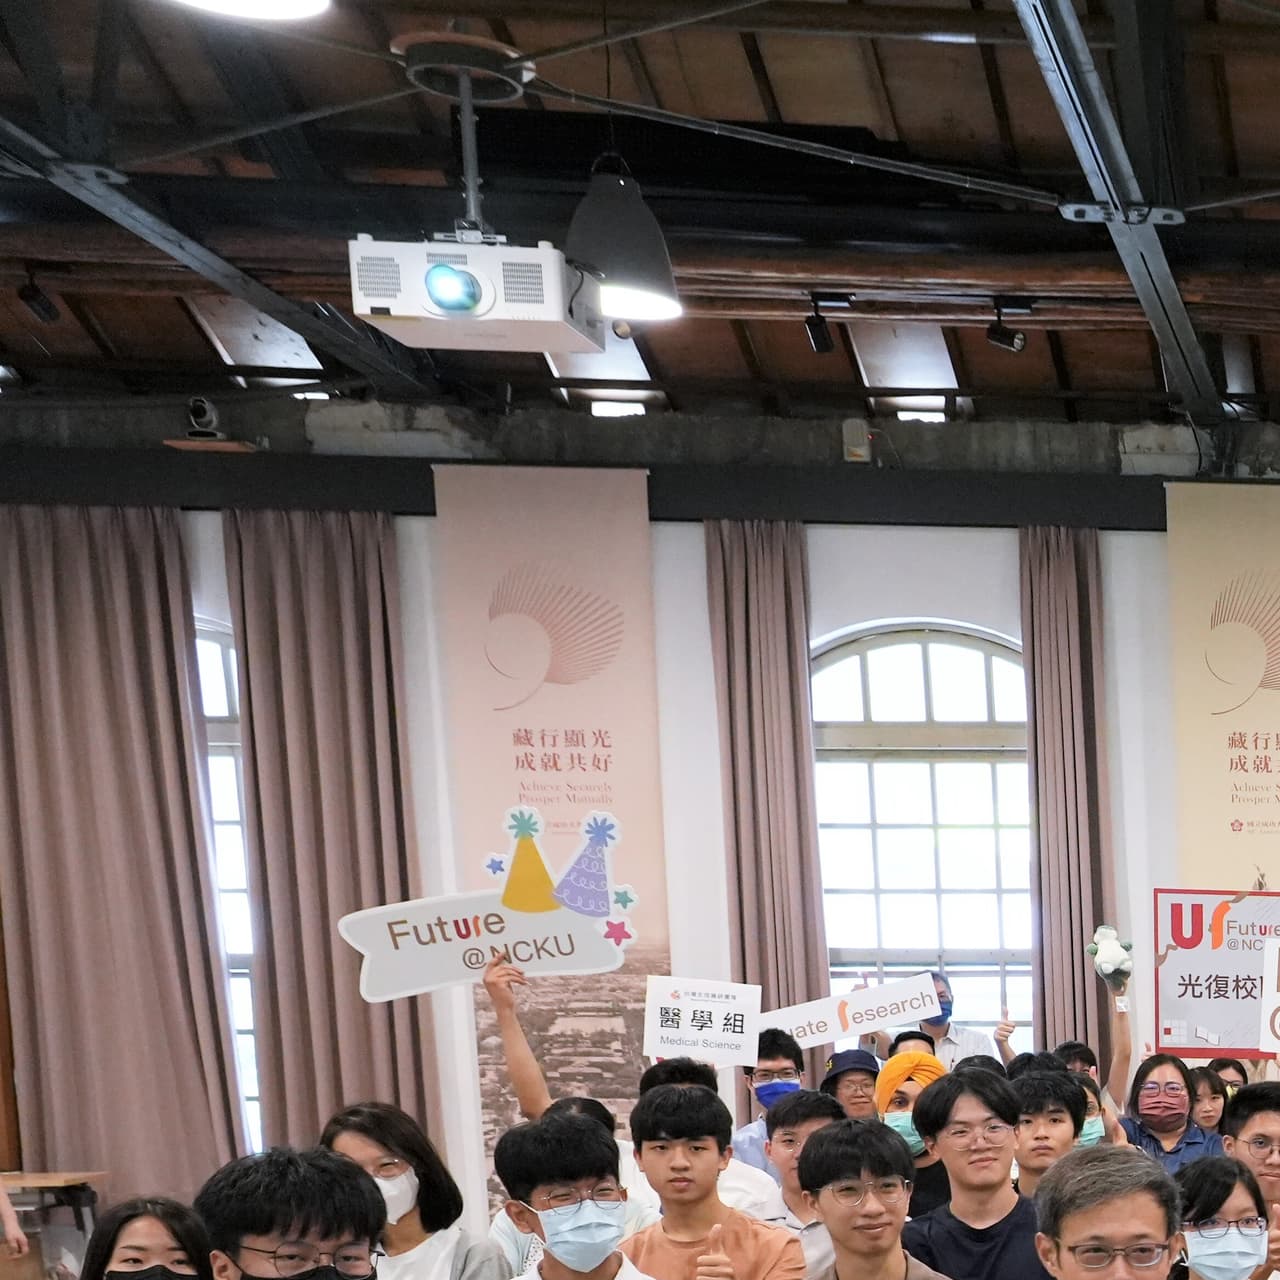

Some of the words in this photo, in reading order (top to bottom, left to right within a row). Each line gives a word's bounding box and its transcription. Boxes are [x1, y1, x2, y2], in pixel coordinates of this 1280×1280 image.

[512, 728, 612, 748] 藏行顯光
[515, 752, 613, 772] 成就共好
[386, 912, 506, 950] Future
[463, 933, 576, 970] @NCKU
[1177, 974, 1264, 1000] 光復校
[659, 1006, 745, 1034] 醫學組
[659, 1035, 699, 1047] Medical
[701, 1037, 742, 1051] Science
